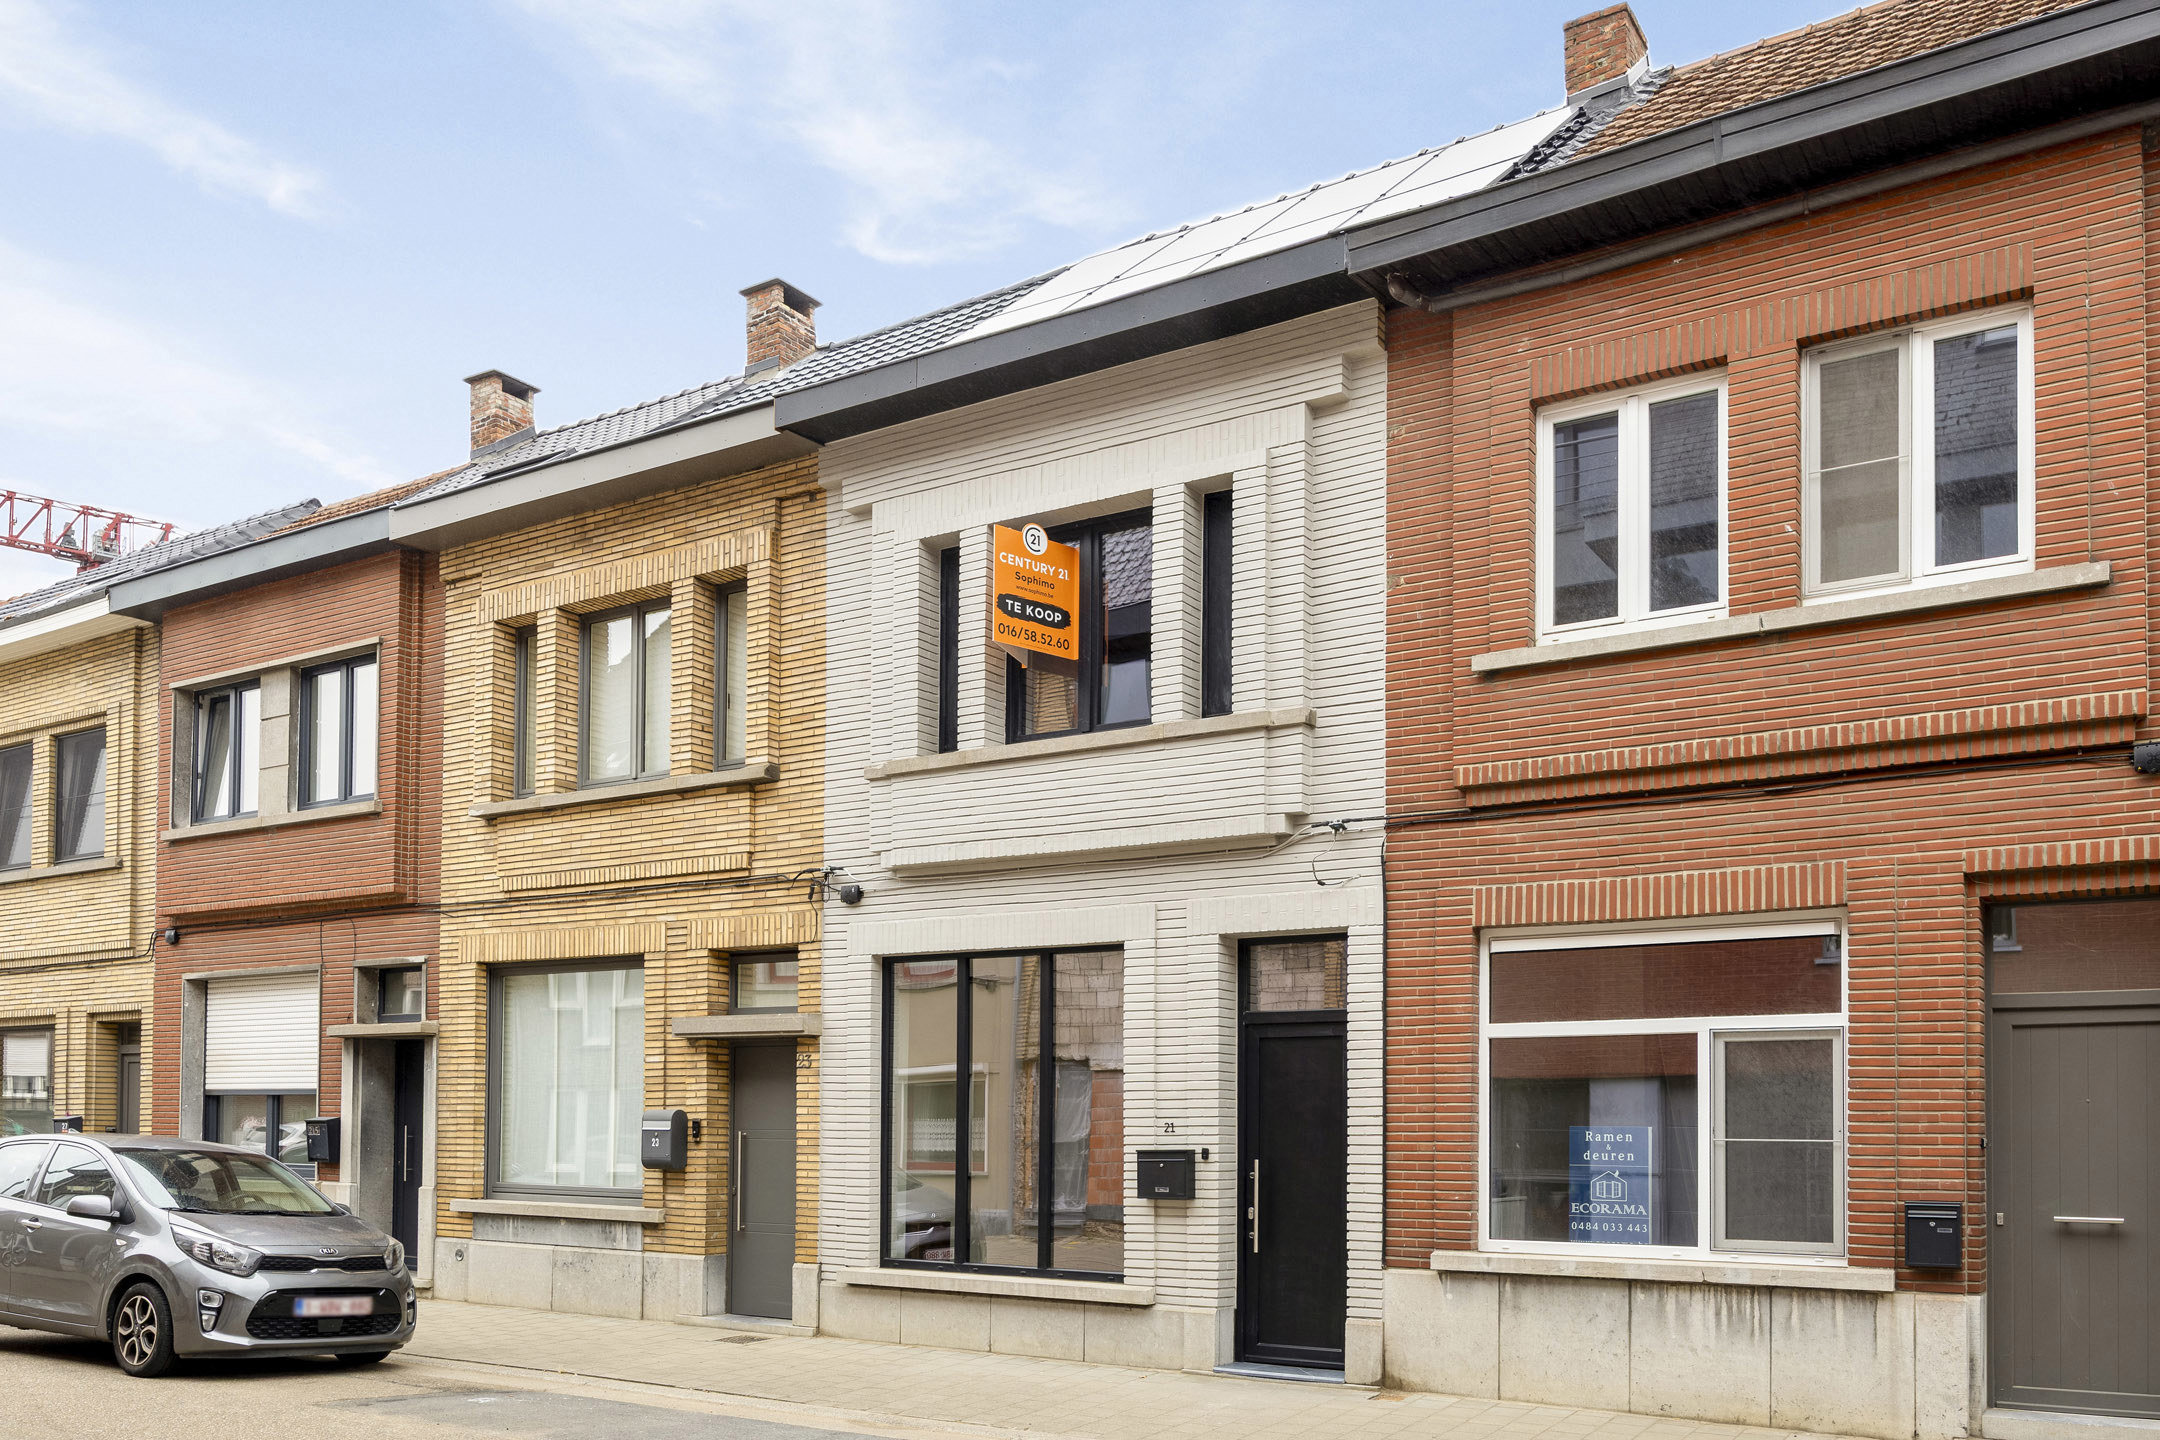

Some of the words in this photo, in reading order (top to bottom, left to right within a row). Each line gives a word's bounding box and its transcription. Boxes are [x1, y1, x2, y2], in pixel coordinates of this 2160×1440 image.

[999, 551, 1056, 577] CENTURY
[1057, 568, 1070, 581] 21
[1015, 571, 1056, 590] Sophimo
[1005, 599, 1022, 614] TE
[1026, 604, 1063, 624] KOOP
[998, 622, 1071, 651] 016/58.52.60
[1164, 1122, 1176, 1133] 21
[651, 1137, 660, 1147] 23
[1585, 1131, 1633, 1142] Ramen
[1605, 1143, 1612, 1151] &
[1583, 1150, 1635, 1161] deuren
[1571, 1202, 1648, 1216] ECORAMA
[1571, 1221, 1599, 1231] 0484
[1602, 1222, 1623, 1232] 033
[1627, 1223, 1648, 1233] 443
[320, 1247, 338, 1255] KIA
